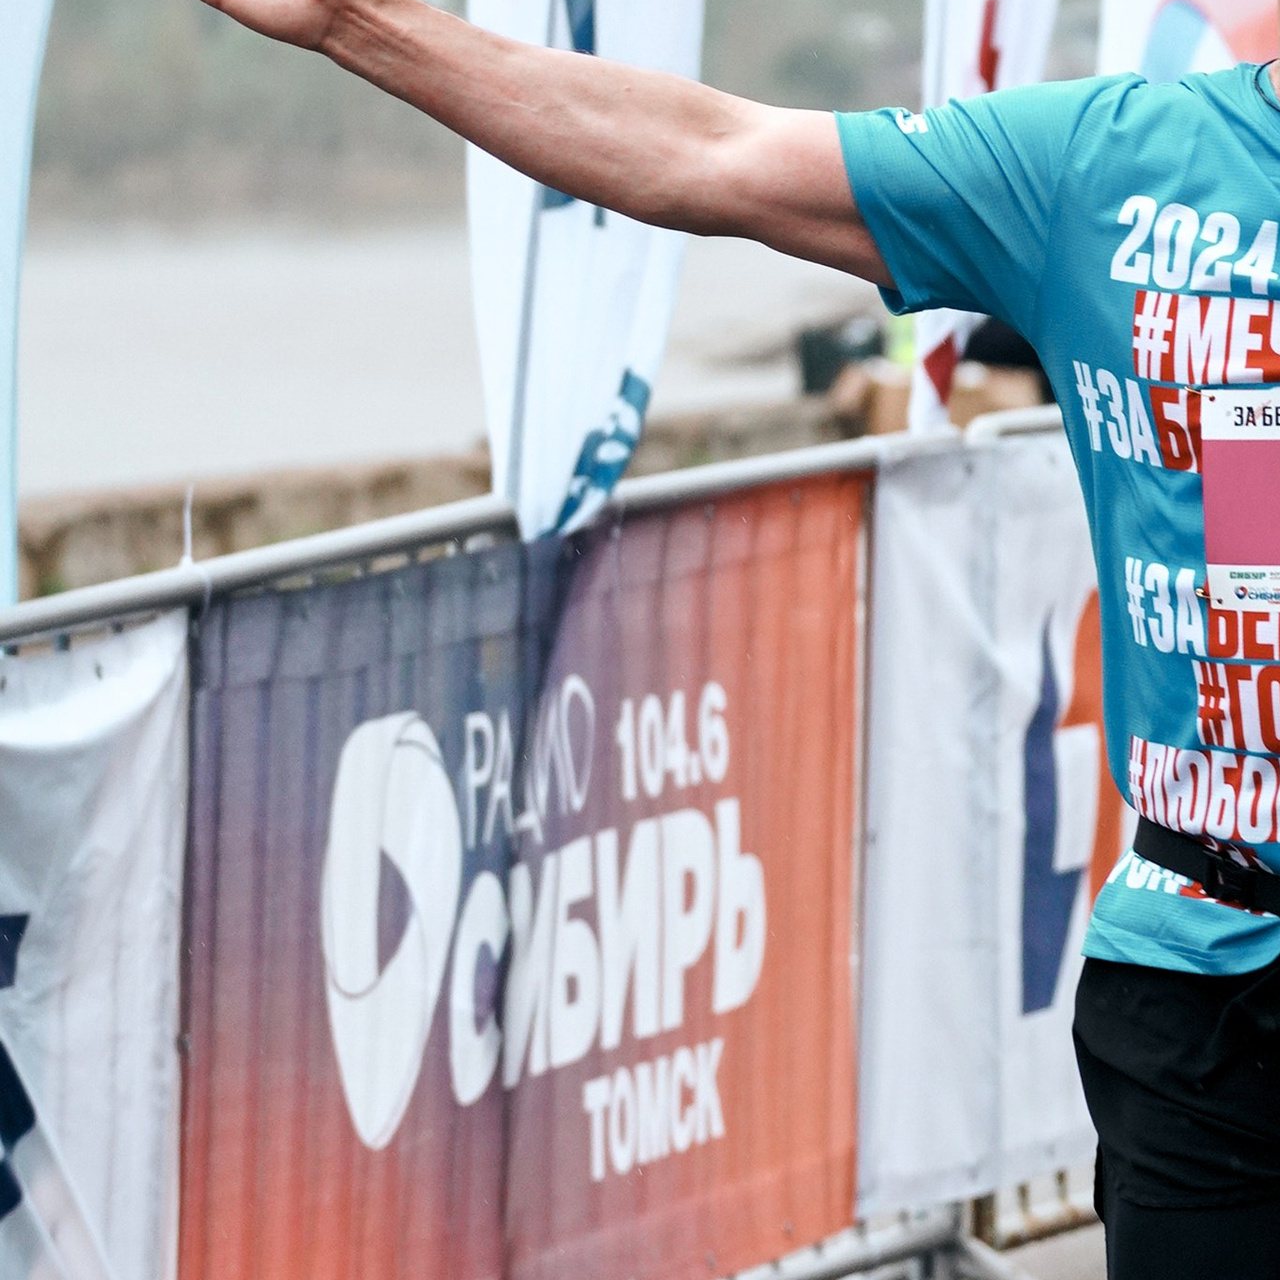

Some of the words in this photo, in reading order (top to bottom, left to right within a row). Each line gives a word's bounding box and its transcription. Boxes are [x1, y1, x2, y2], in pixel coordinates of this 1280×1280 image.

[1110, 194, 1280, 295] 2024
[1072, 360, 1202, 474] #ЗАБ
[617, 681, 730, 802] 104.6
[450, 797, 767, 1107] СИБИРЬ
[584, 1037, 725, 1183] ТОМСК
